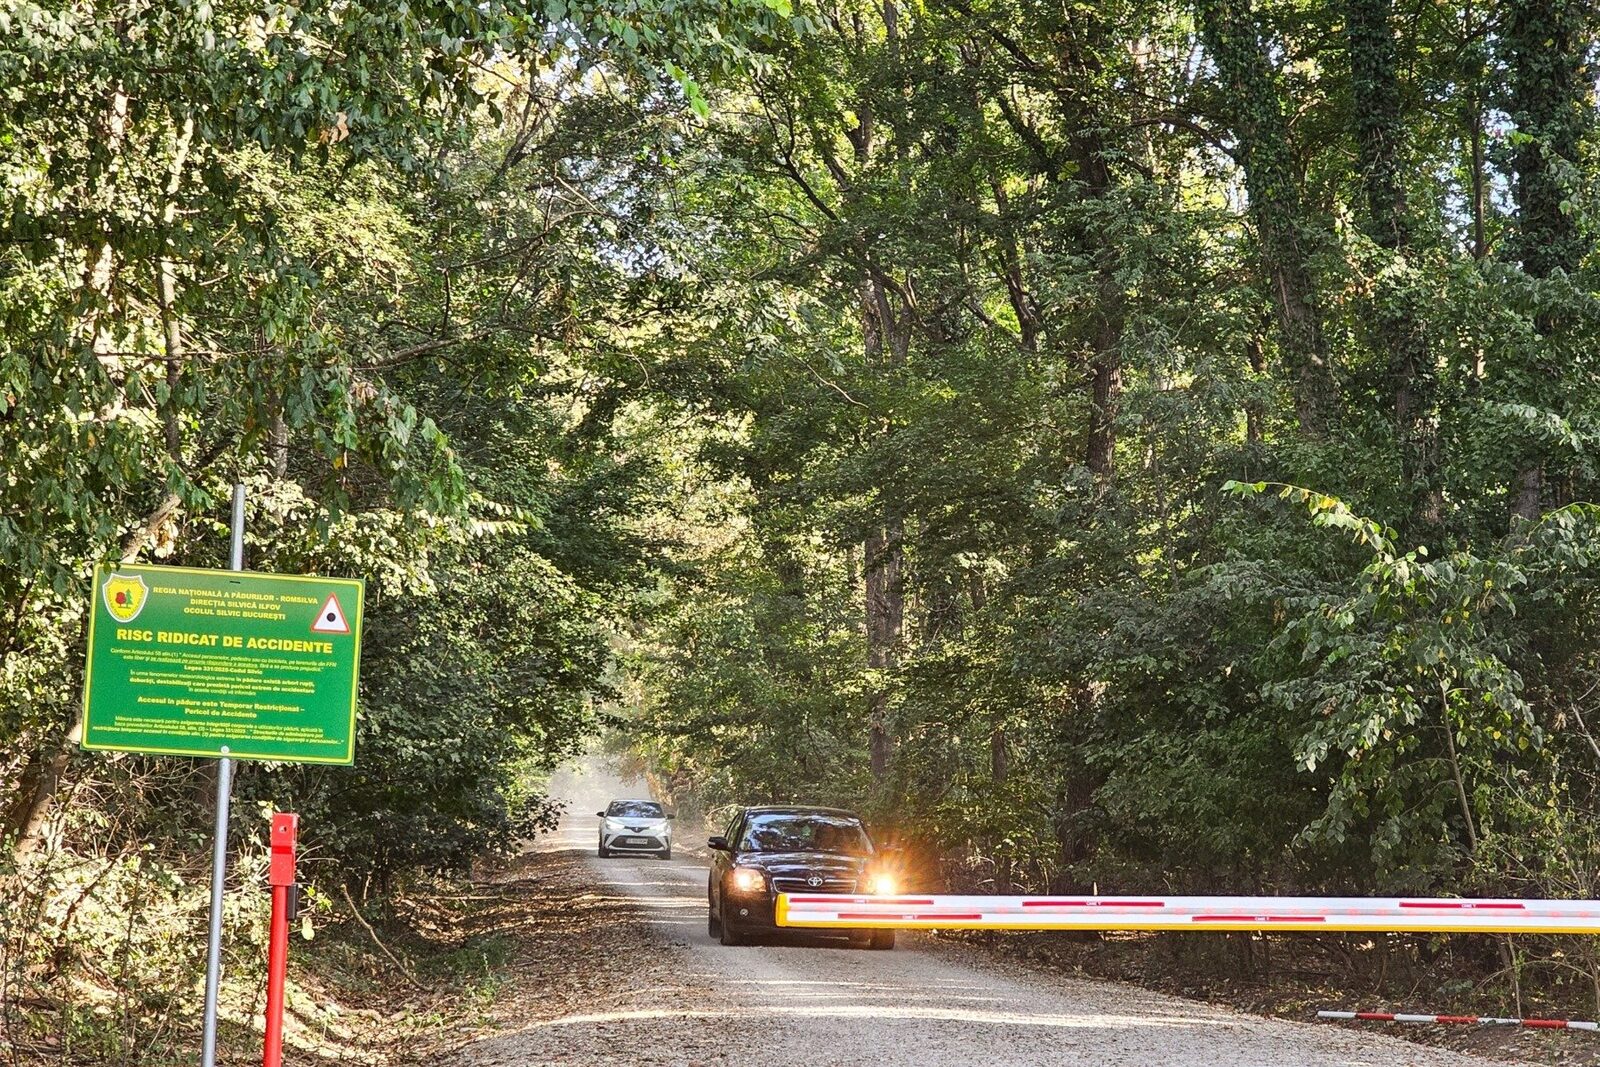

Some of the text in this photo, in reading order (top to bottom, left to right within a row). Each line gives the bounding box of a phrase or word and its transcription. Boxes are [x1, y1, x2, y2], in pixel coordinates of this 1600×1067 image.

[190, 598, 226, 608] DIRECȚIA
[227, 600, 257, 608] SILVICĂ
[231, 592, 274, 601] PĂDURILOR
[280, 596, 318, 604] ROMSILVA
[184, 607, 215, 615] OCOLUL
[242, 611, 286, 621] BUCUREȘTI
[116, 629, 333, 653] RISC RIDICAT DE ACCIDENTE
[220, 702, 253, 710] Temporar
[221, 710, 257, 718] Accidente
